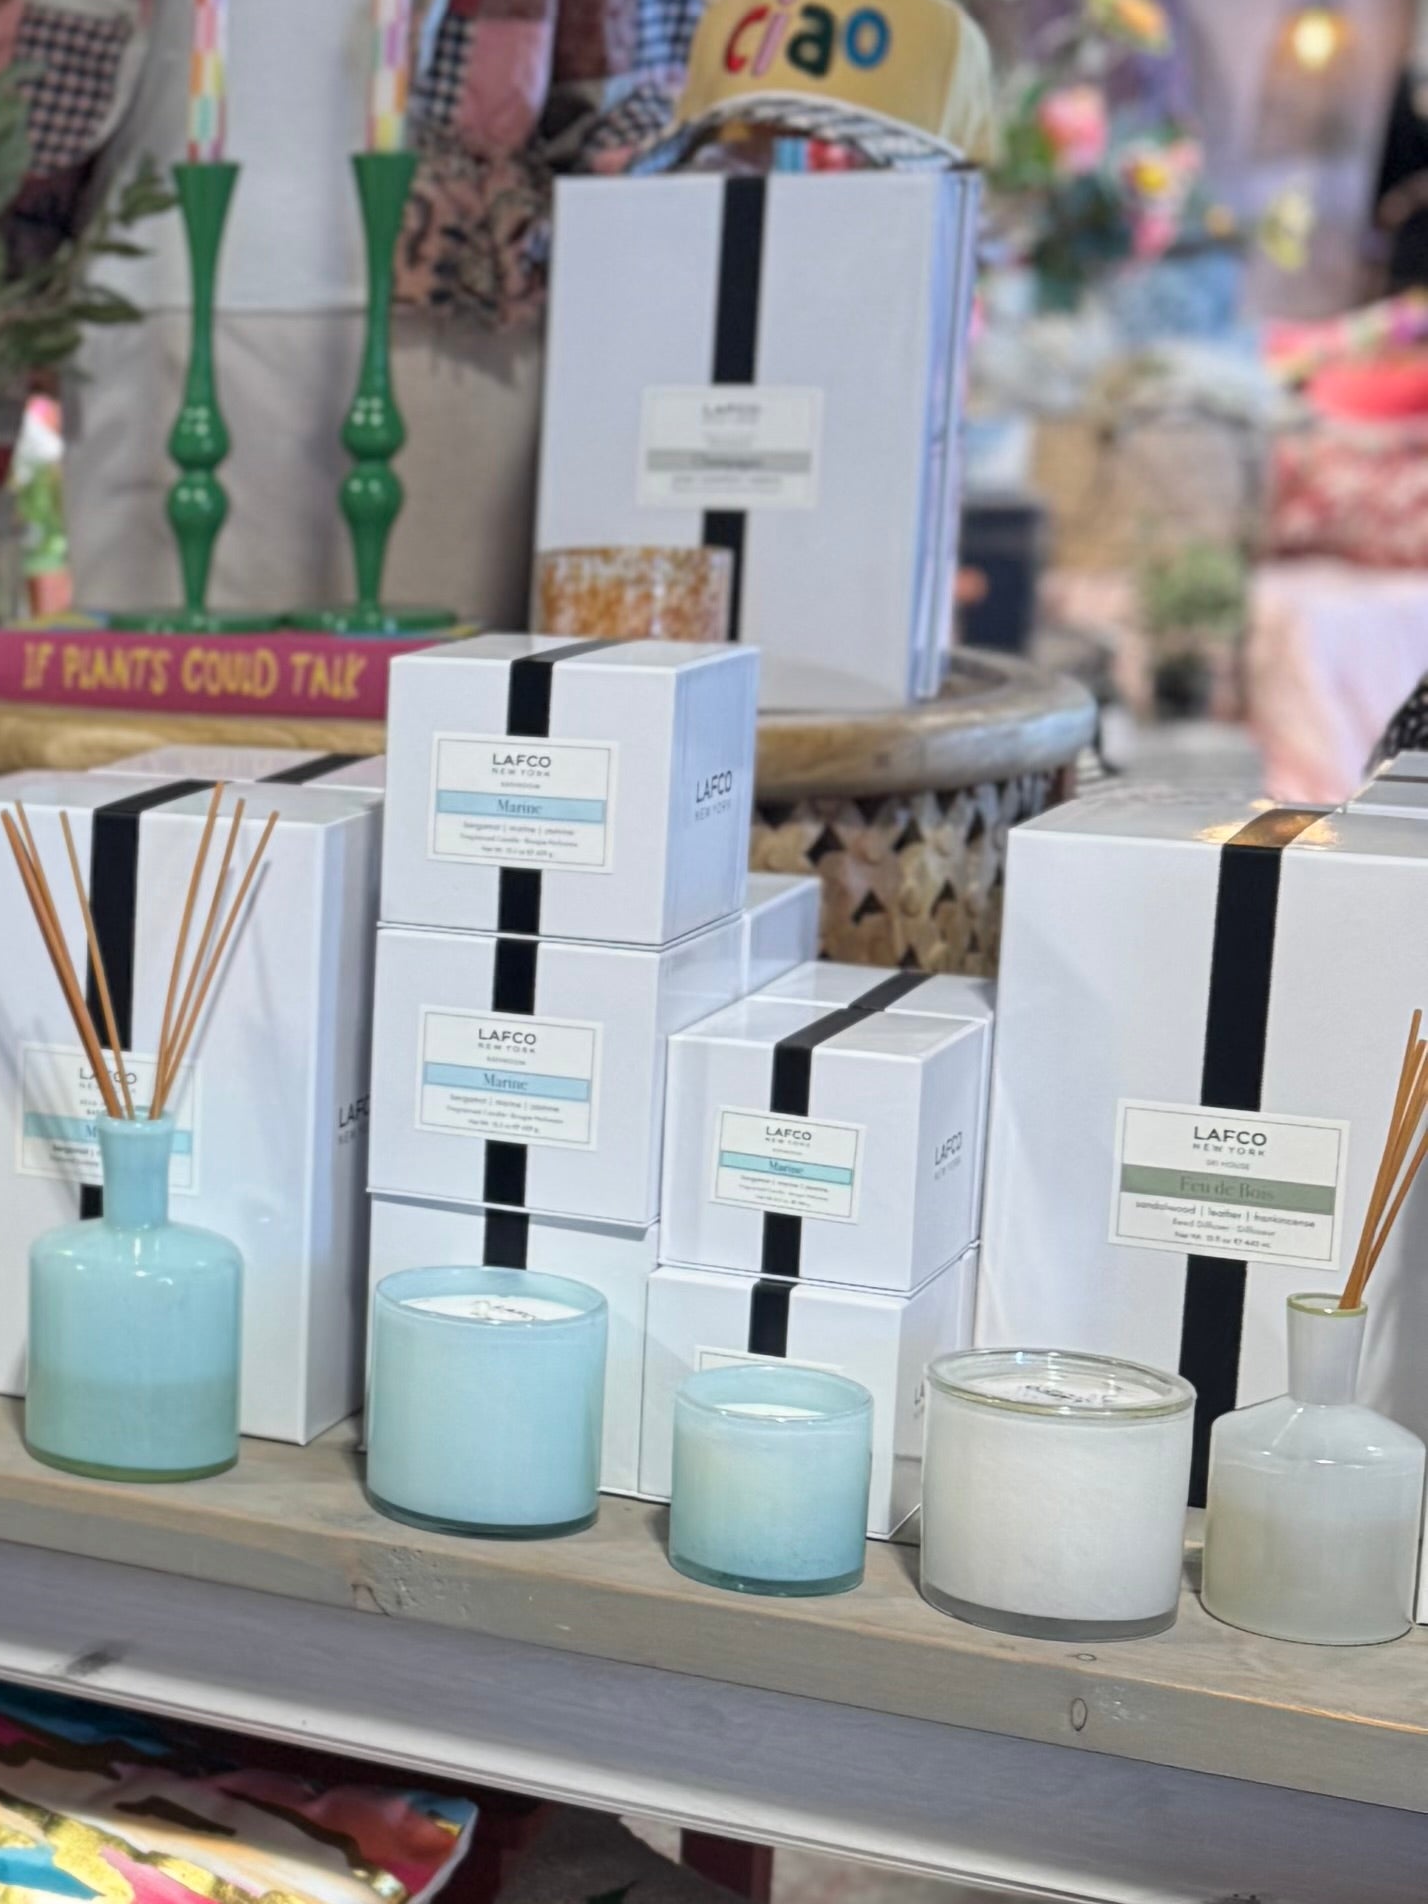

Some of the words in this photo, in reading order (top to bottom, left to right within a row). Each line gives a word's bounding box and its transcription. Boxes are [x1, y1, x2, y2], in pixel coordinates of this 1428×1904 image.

[21, 641, 54, 691] IF
[62, 644, 173, 695] PLANTS
[181, 648, 278, 700] COULD
[289, 652, 368, 700] TALK
[492, 753, 551, 768] LAFCO
[492, 768, 516, 776] NEW
[521, 768, 551, 777] YORK
[696, 770, 732, 803] LAFCO
[496, 799, 542, 815] Marine
[478, 1028, 536, 1046] LAFCO
[478, 1042, 502, 1050] NEW
[506, 1045, 536, 1054] YORK
[80, 1067, 137, 1085] LACO
[482, 1073, 528, 1091] Marine
[766, 1126, 812, 1141] LAFCO
[1194, 1126, 1267, 1146] LAFCO
[935, 1131, 962, 1166] LAFCO
[1193, 1143, 1223, 1153] NEW
[1229, 1146, 1265, 1156] YORK
[769, 1160, 804, 1174] Marine
[1180, 1176, 1211, 1194] Feu
[1215, 1180, 1233, 1196] de
[1239, 1182, 1274, 1201] Bois
[1136, 1200, 1196, 1215] sandalwood
